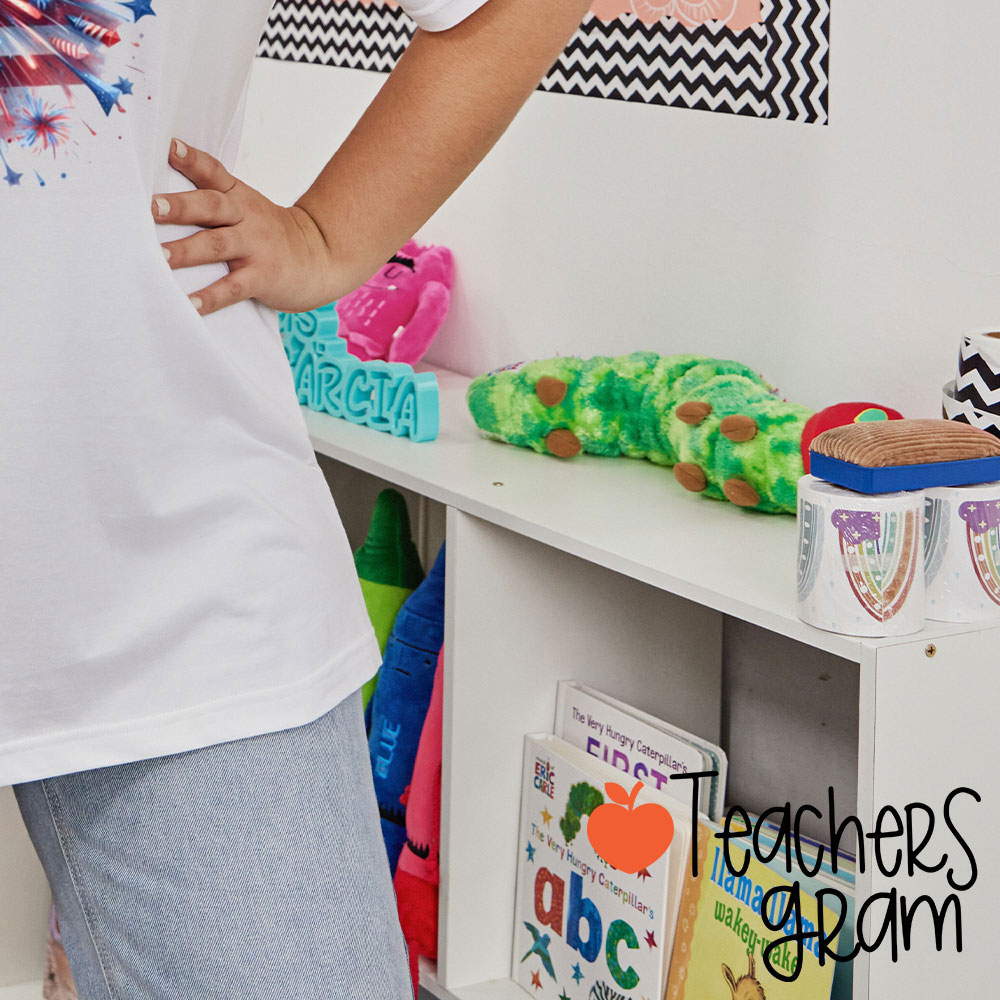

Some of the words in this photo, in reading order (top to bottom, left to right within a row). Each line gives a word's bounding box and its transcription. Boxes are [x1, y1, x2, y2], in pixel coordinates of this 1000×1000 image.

[375, 718, 401, 780] BLUE
[572, 706, 586, 724] The
[586, 713, 605, 736] Very
[605, 724, 635, 752] Hungry
[636, 739, 688, 775] Caterpillar's
[533, 775, 555, 801] CARLE
[535, 761, 555, 786] ERIC
[531, 822, 545, 843] The
[547, 834, 565, 861] Very
[566, 848, 597, 884] Hungry
[598, 873, 655, 920] Caterpillar's
[534, 866, 640, 990] abc
